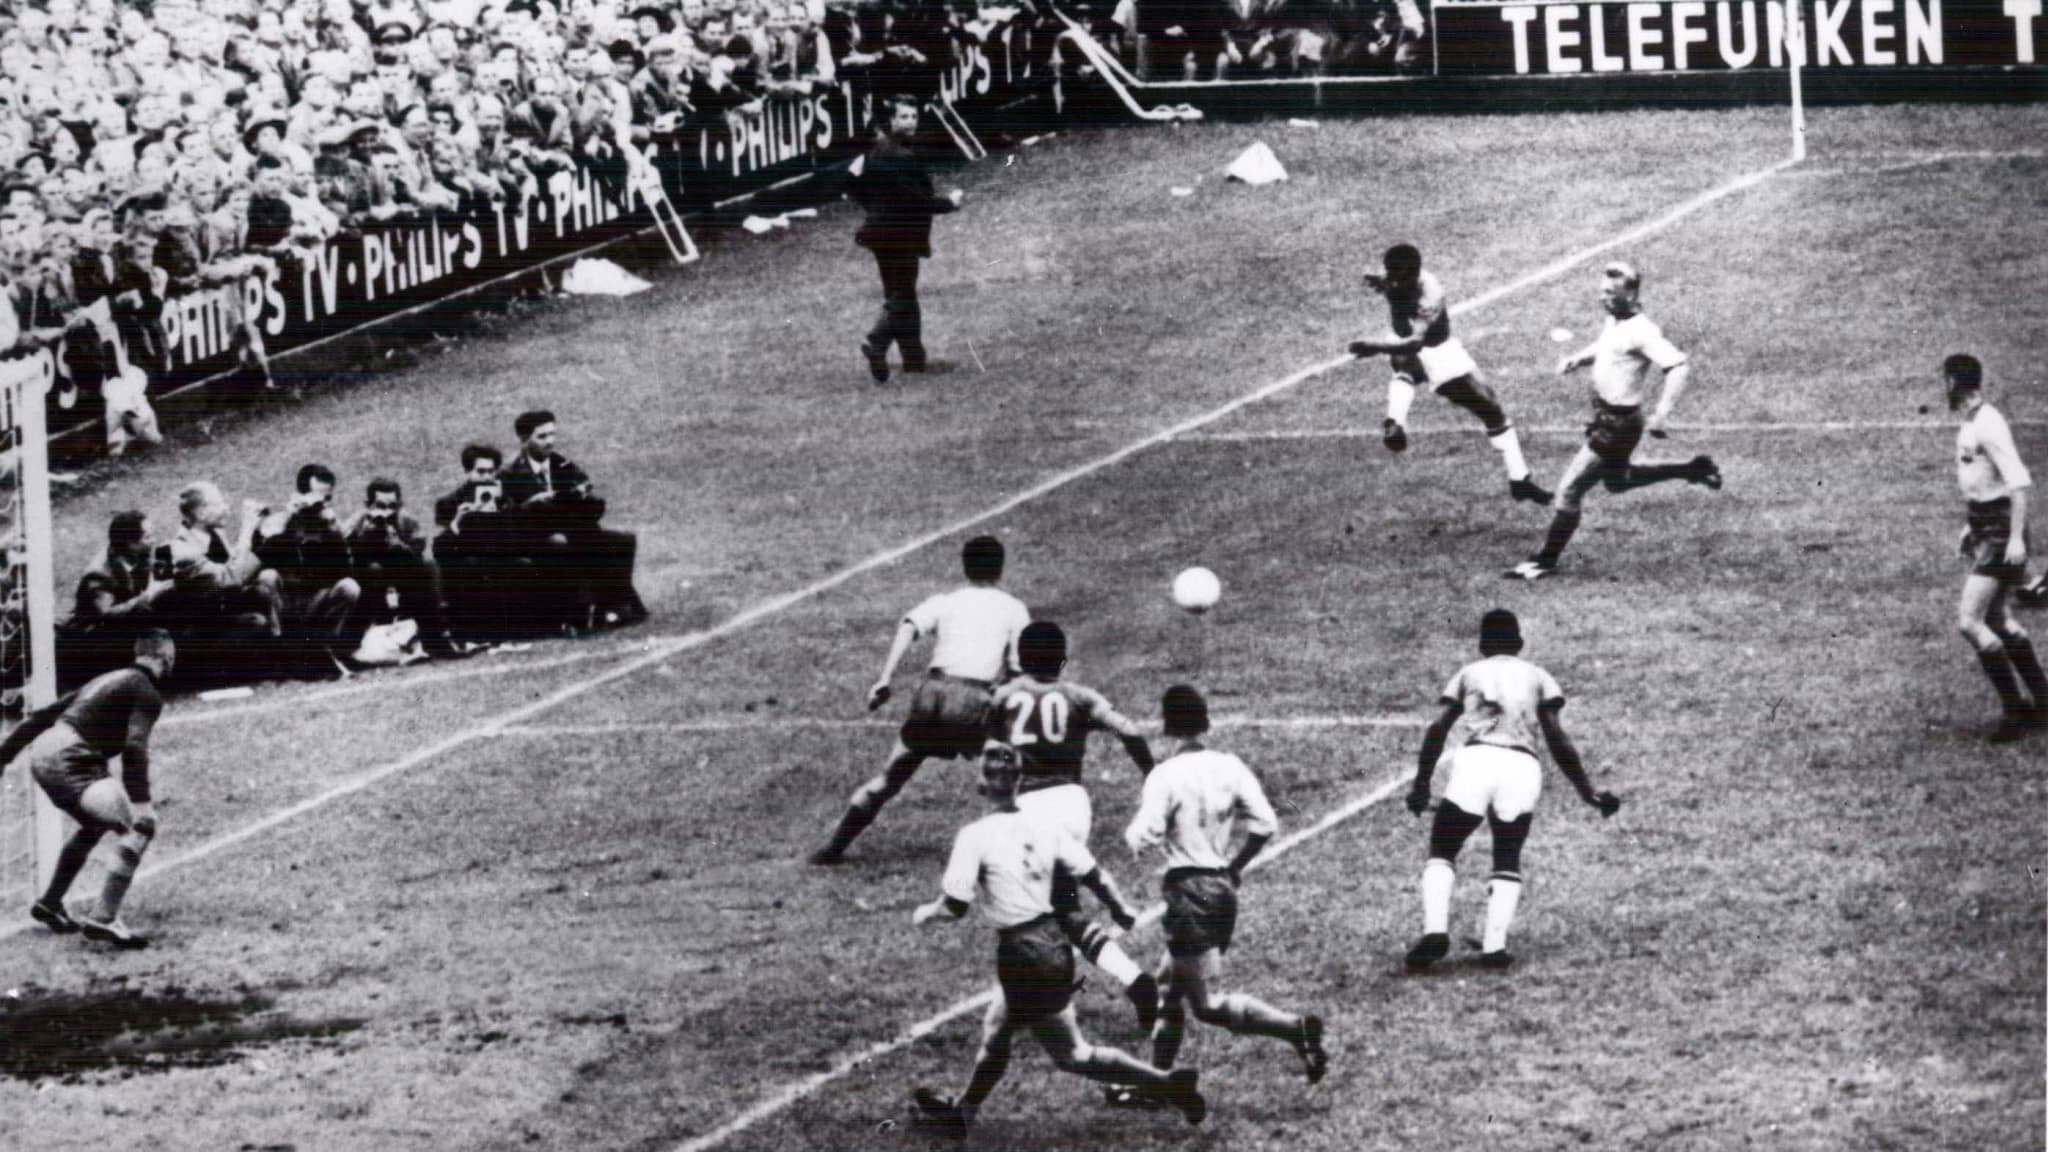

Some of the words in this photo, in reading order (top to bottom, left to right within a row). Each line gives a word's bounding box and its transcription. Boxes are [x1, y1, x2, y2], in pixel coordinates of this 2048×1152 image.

[1502, 0, 1943, 74] TELEFUNKEN
[161, 260, 286, 371] PHILPS
[293, 245, 338, 322] TV
[363, 211, 482, 300] PHILIPS
[728, 94, 832, 177] PHILIPS
[941, 44, 991, 102] LIPS
[1006, 692, 1068, 745] 20
